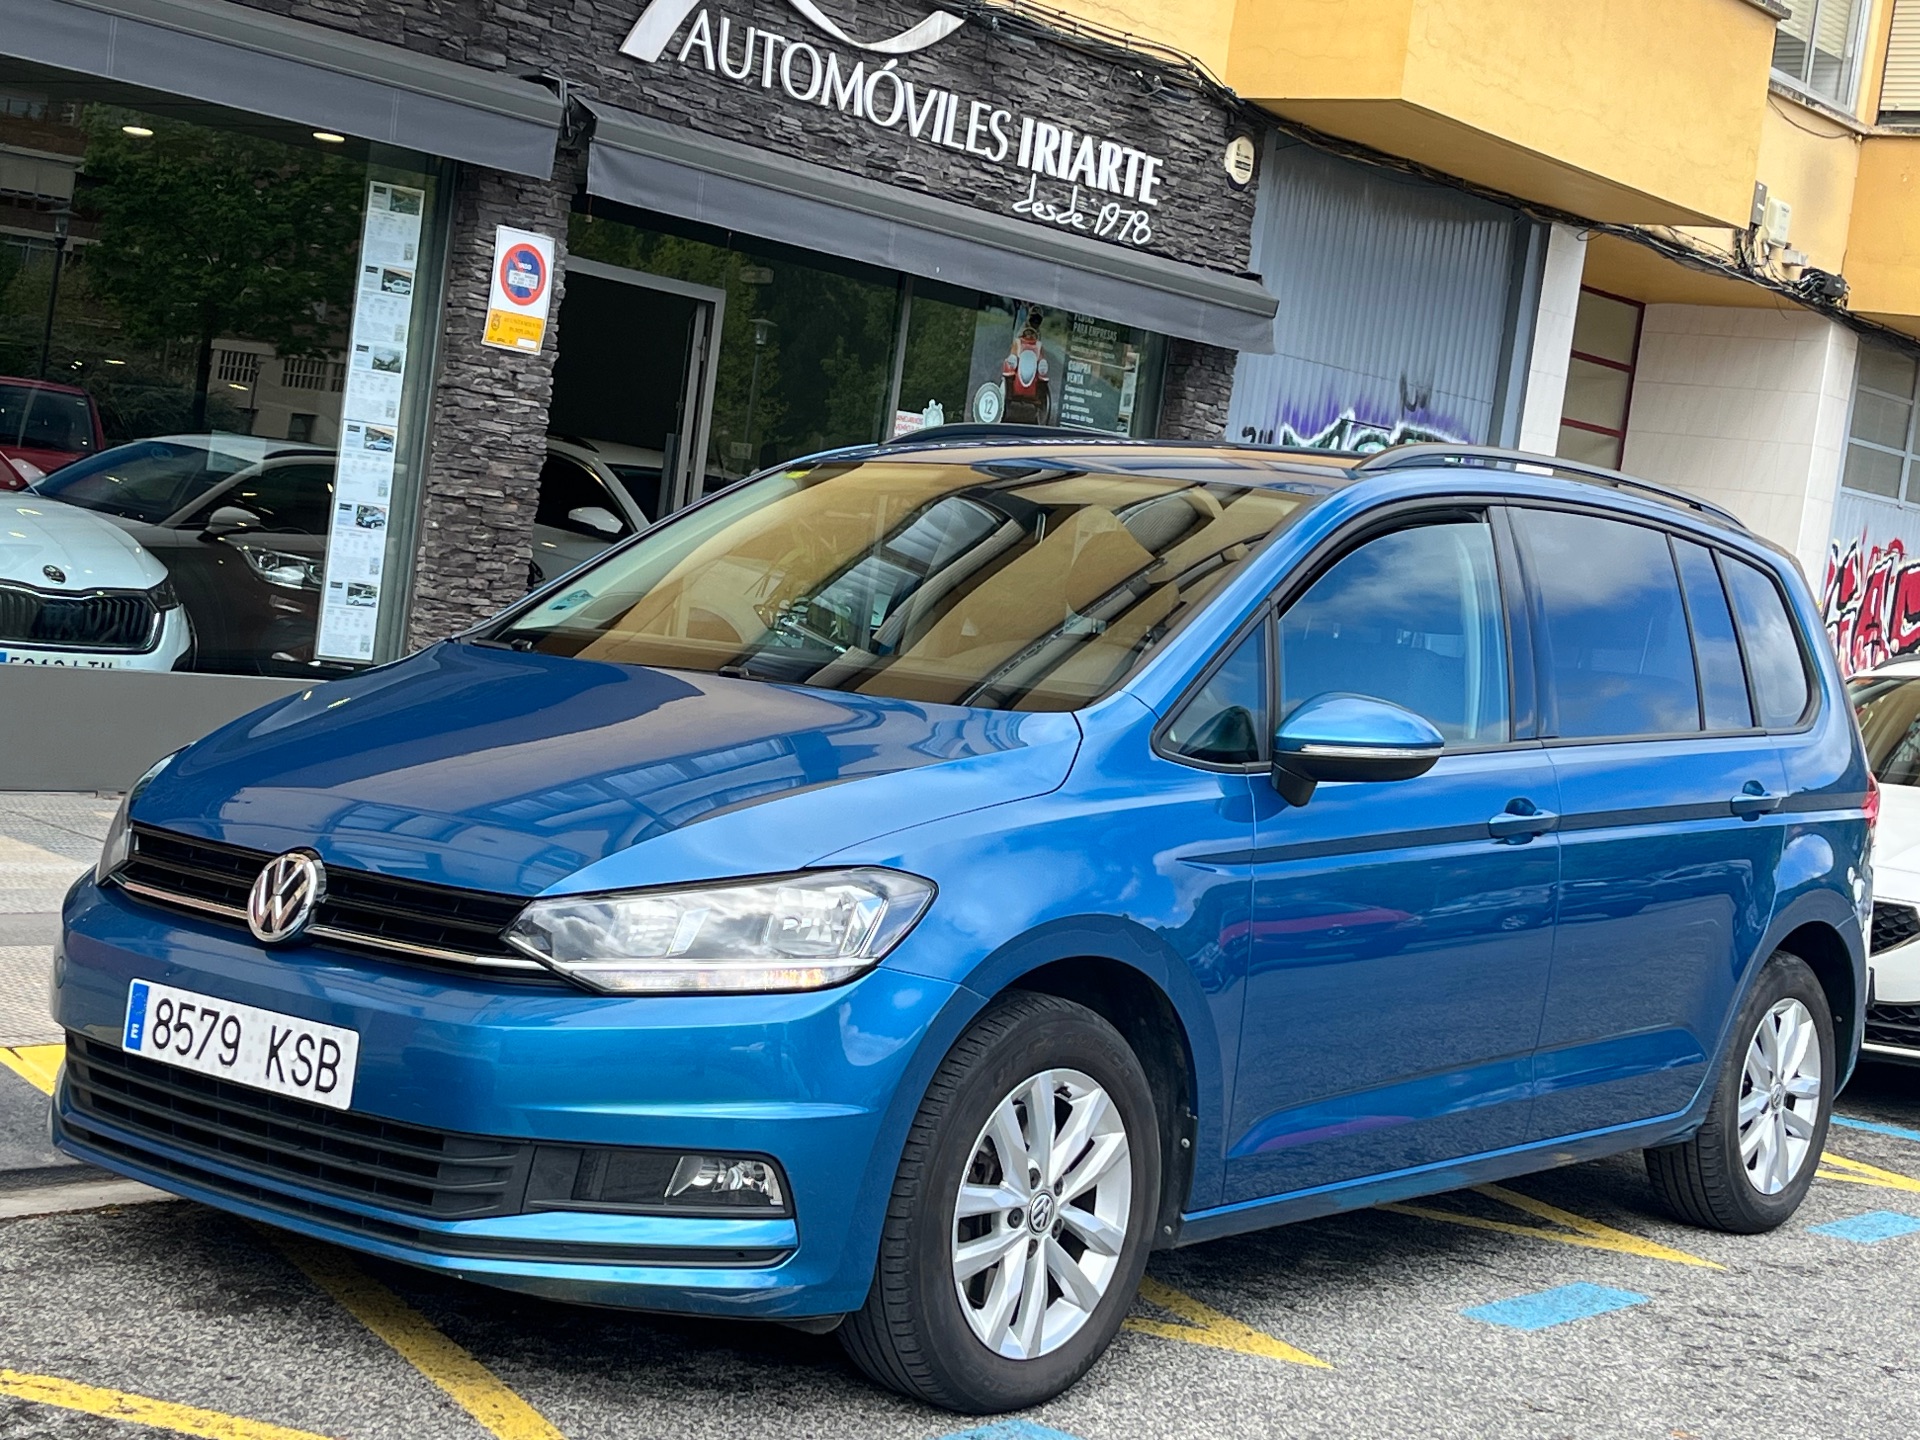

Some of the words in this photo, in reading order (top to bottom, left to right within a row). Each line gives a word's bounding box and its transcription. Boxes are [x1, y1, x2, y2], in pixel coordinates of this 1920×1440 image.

[676, 9, 1012, 162] AUTOMÓVILES
[1016, 117, 1163, 206] IRIARTE
[1012, 173, 1089, 230] desde
[1093, 202, 1151, 245] 1978
[984, 399, 994, 415] 12
[151, 998, 242, 1067] 8579
[265, 1024, 342, 1094] KSB
